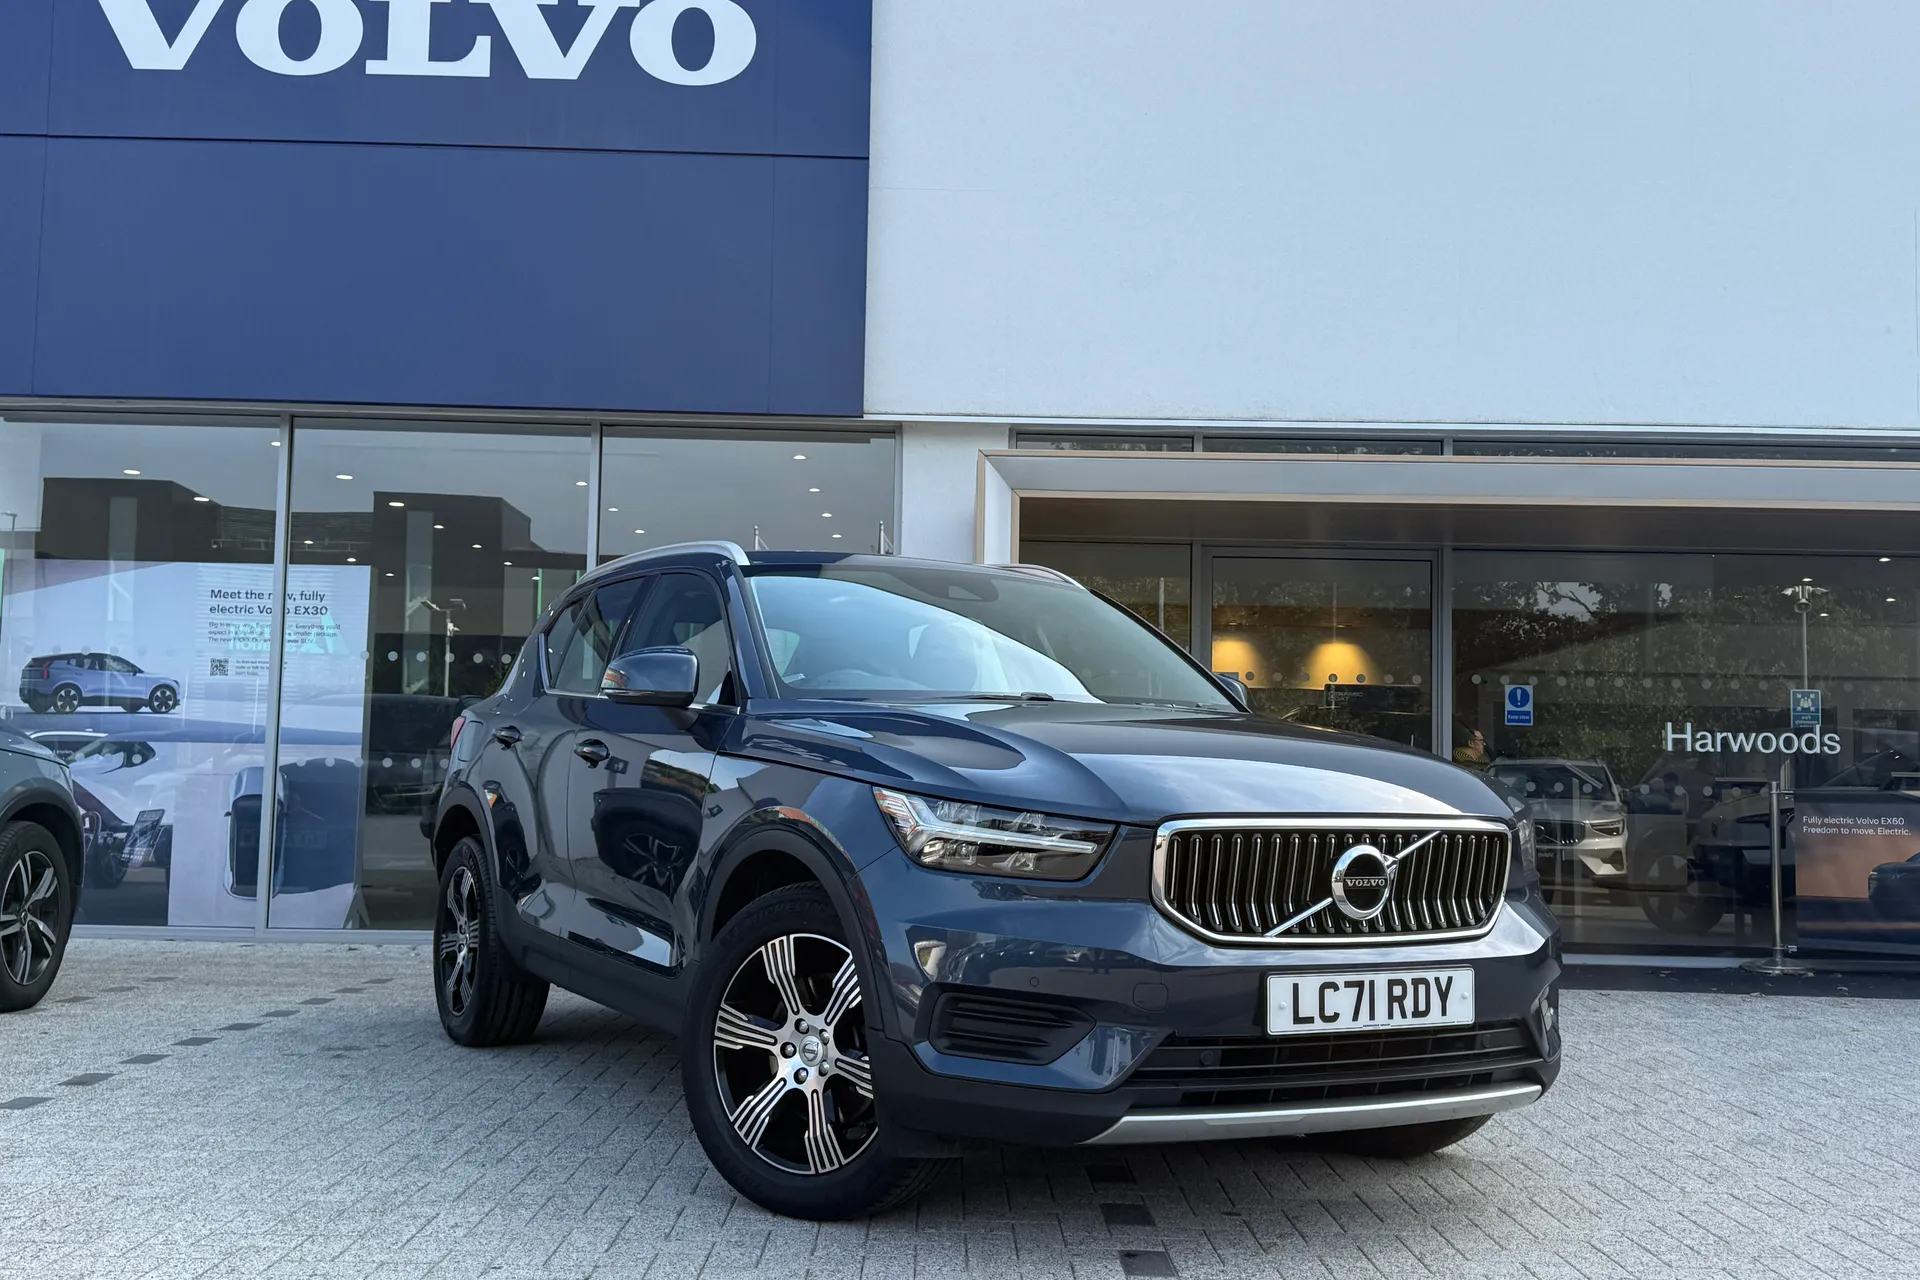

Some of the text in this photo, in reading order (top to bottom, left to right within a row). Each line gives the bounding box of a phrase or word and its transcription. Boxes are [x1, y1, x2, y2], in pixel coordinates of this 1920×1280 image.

[99, 0, 757, 86] VOLVO
[210, 589, 326, 603] Meet the nw, fully
[209, 604, 254, 615] electric
[294, 605, 328, 616] EX30
[1666, 721, 1842, 755] Harwoods
[1802, 815, 1905, 825] Fully electric Volvo EX60
[1803, 825, 1912, 836] Freedom to move. Electric.
[1345, 878, 1386, 887] VOLVO
[1292, 975, 1454, 1025] LC71 RDY
